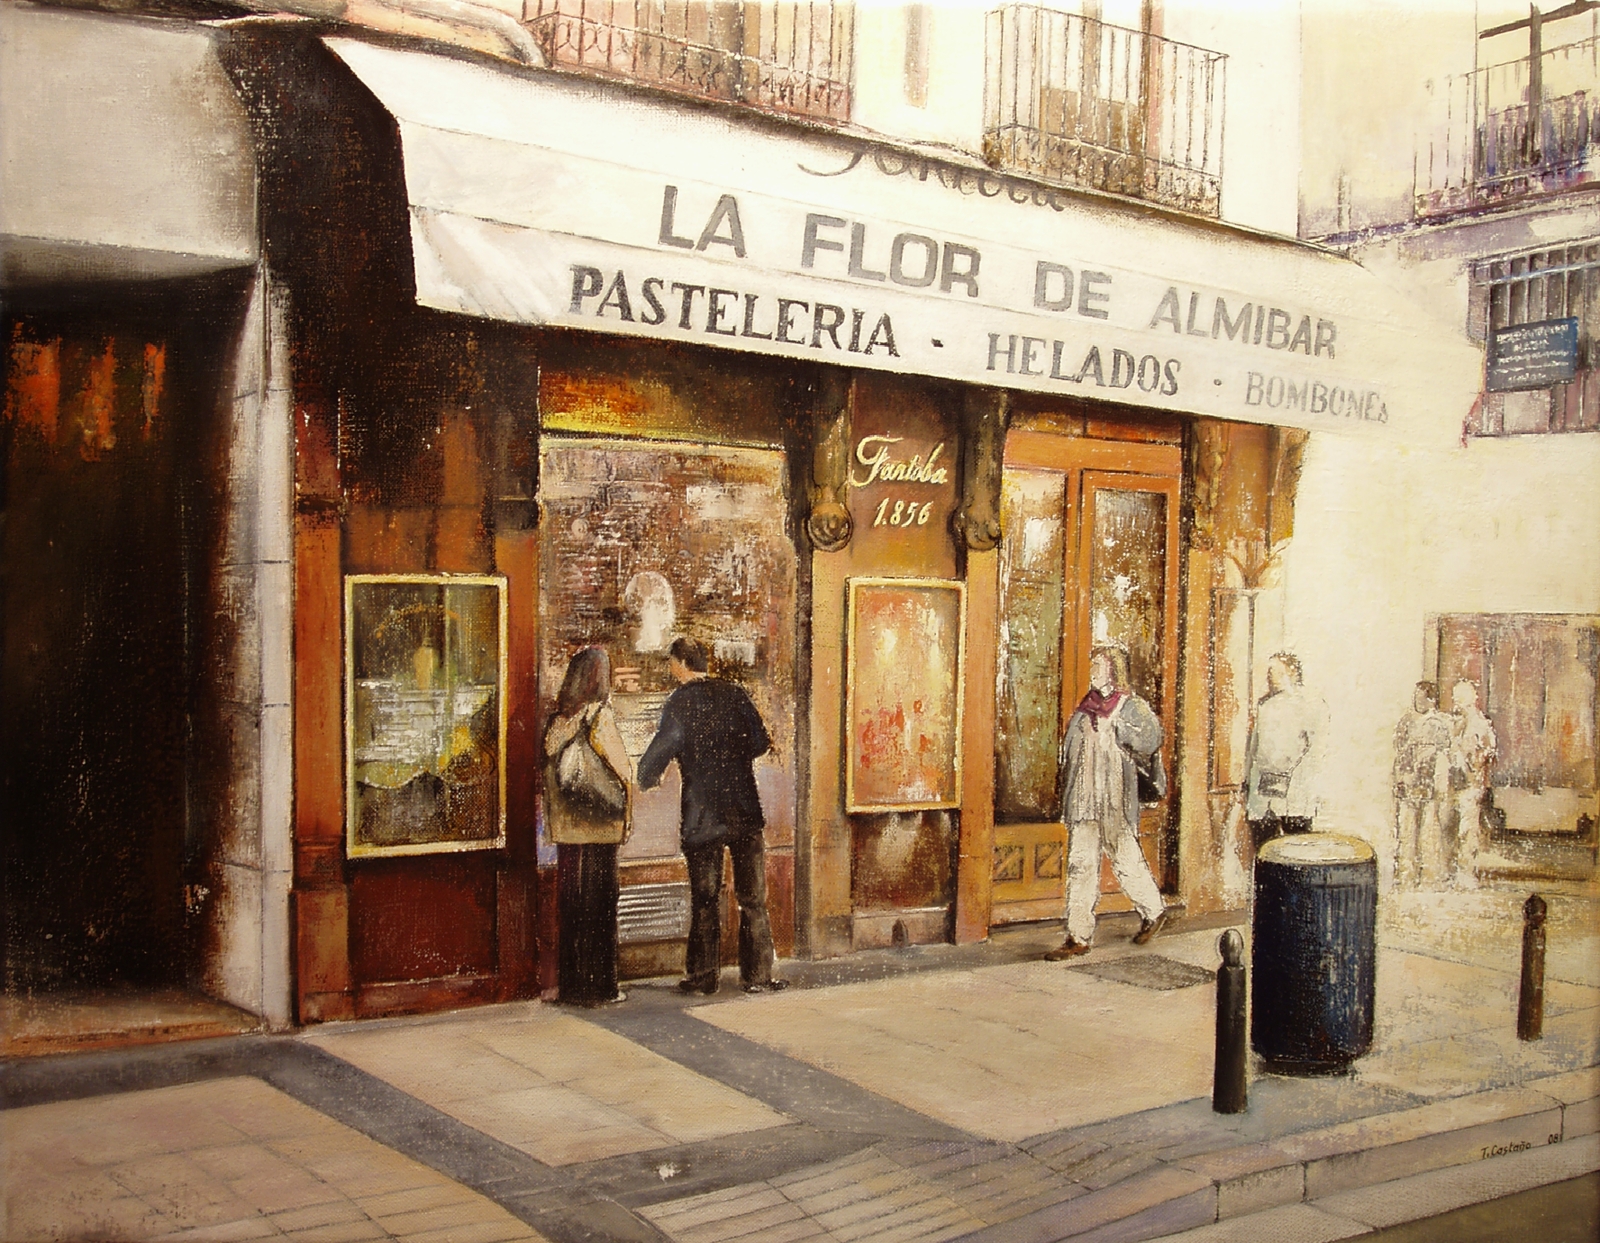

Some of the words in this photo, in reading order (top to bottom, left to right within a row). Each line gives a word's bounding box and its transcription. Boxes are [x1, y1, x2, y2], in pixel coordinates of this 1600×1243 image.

[569, 265, 902, 358] PASTELERIA
[986, 333, 1180, 396] HELADOS
[659, 185, 746, 258] LA
[801, 213, 982, 299] FLOR
[1034, 260, 1112, 319] DE
[1150, 287, 1337, 360] ALMIBAR
